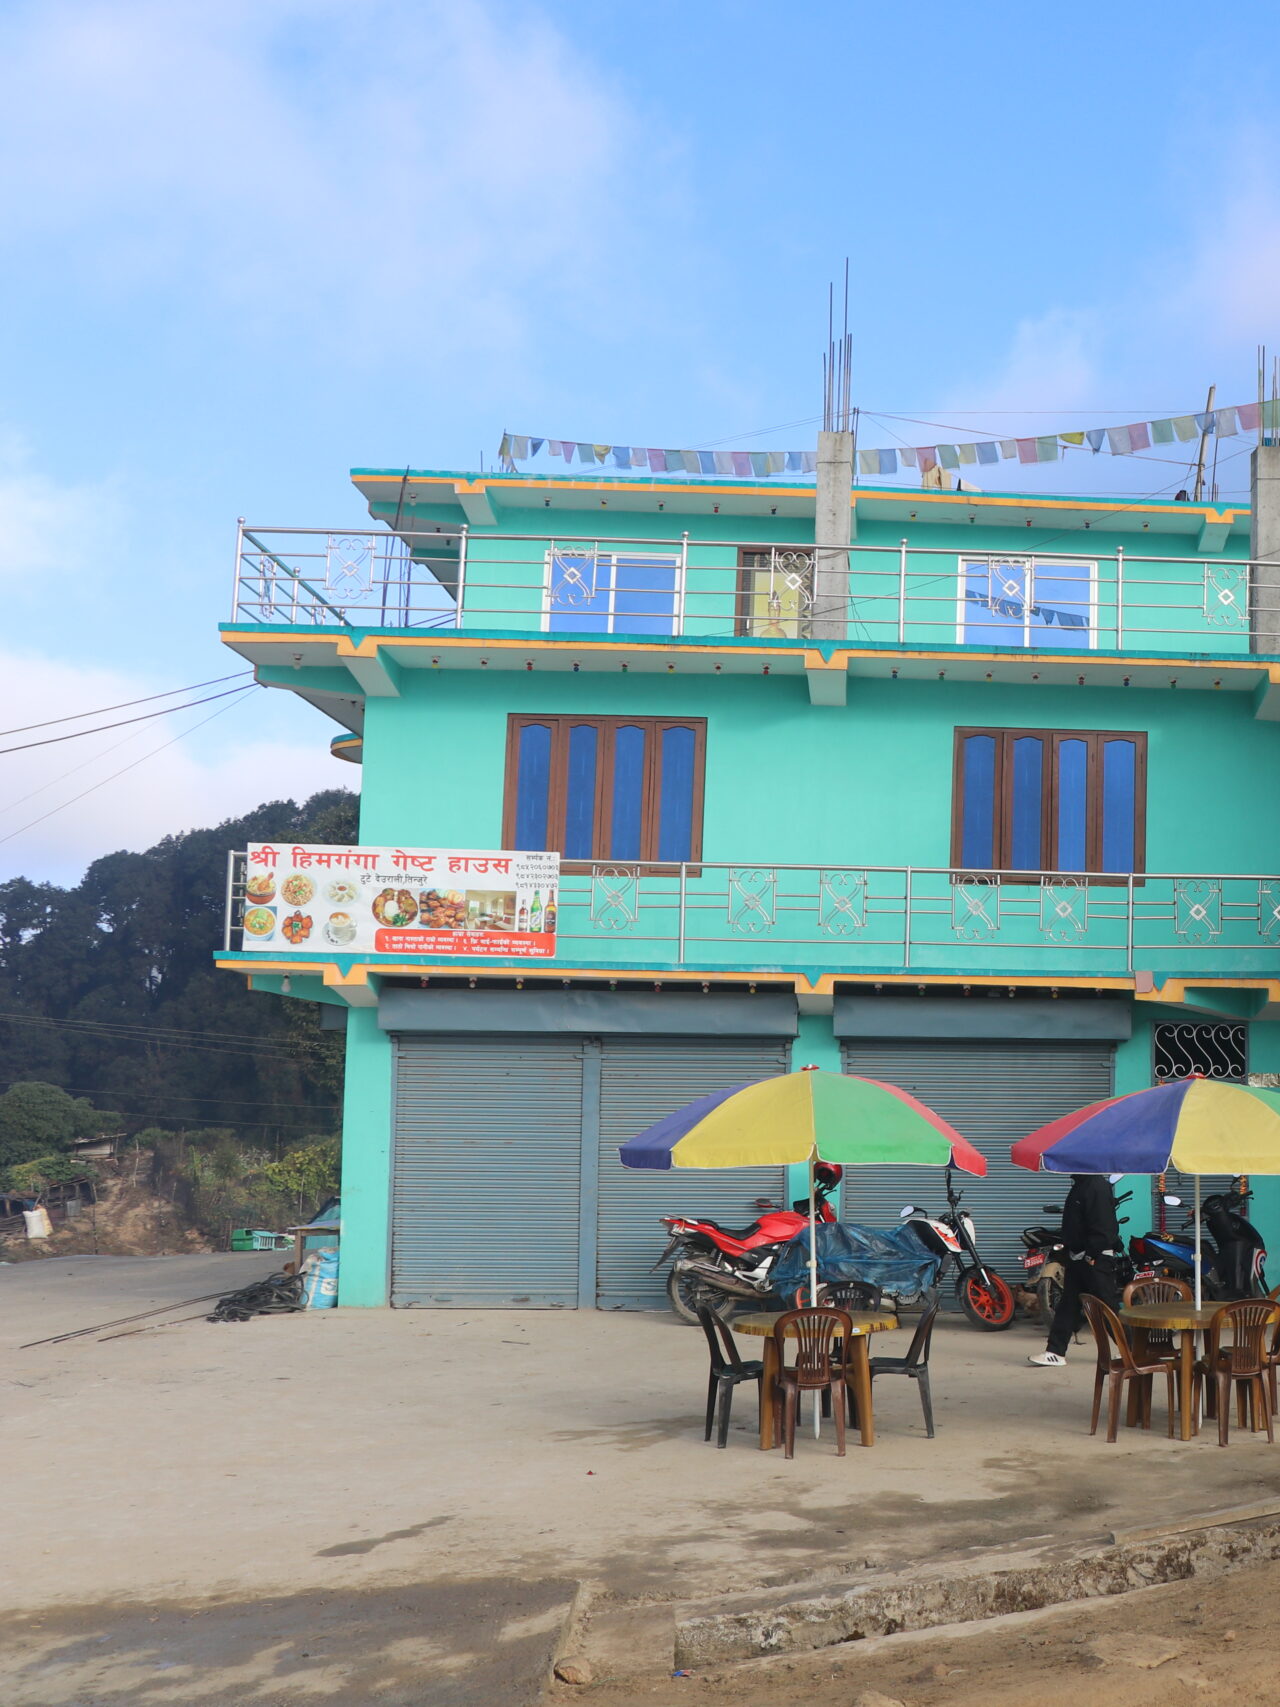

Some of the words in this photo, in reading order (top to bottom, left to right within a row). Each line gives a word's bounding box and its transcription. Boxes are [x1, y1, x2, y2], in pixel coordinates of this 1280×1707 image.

[250, 845, 280, 868] श्री
[291, 846, 380, 870] हिमगंगा
[391, 850, 437, 872] गेष्ट
[448, 856, 513, 874] हाउस
